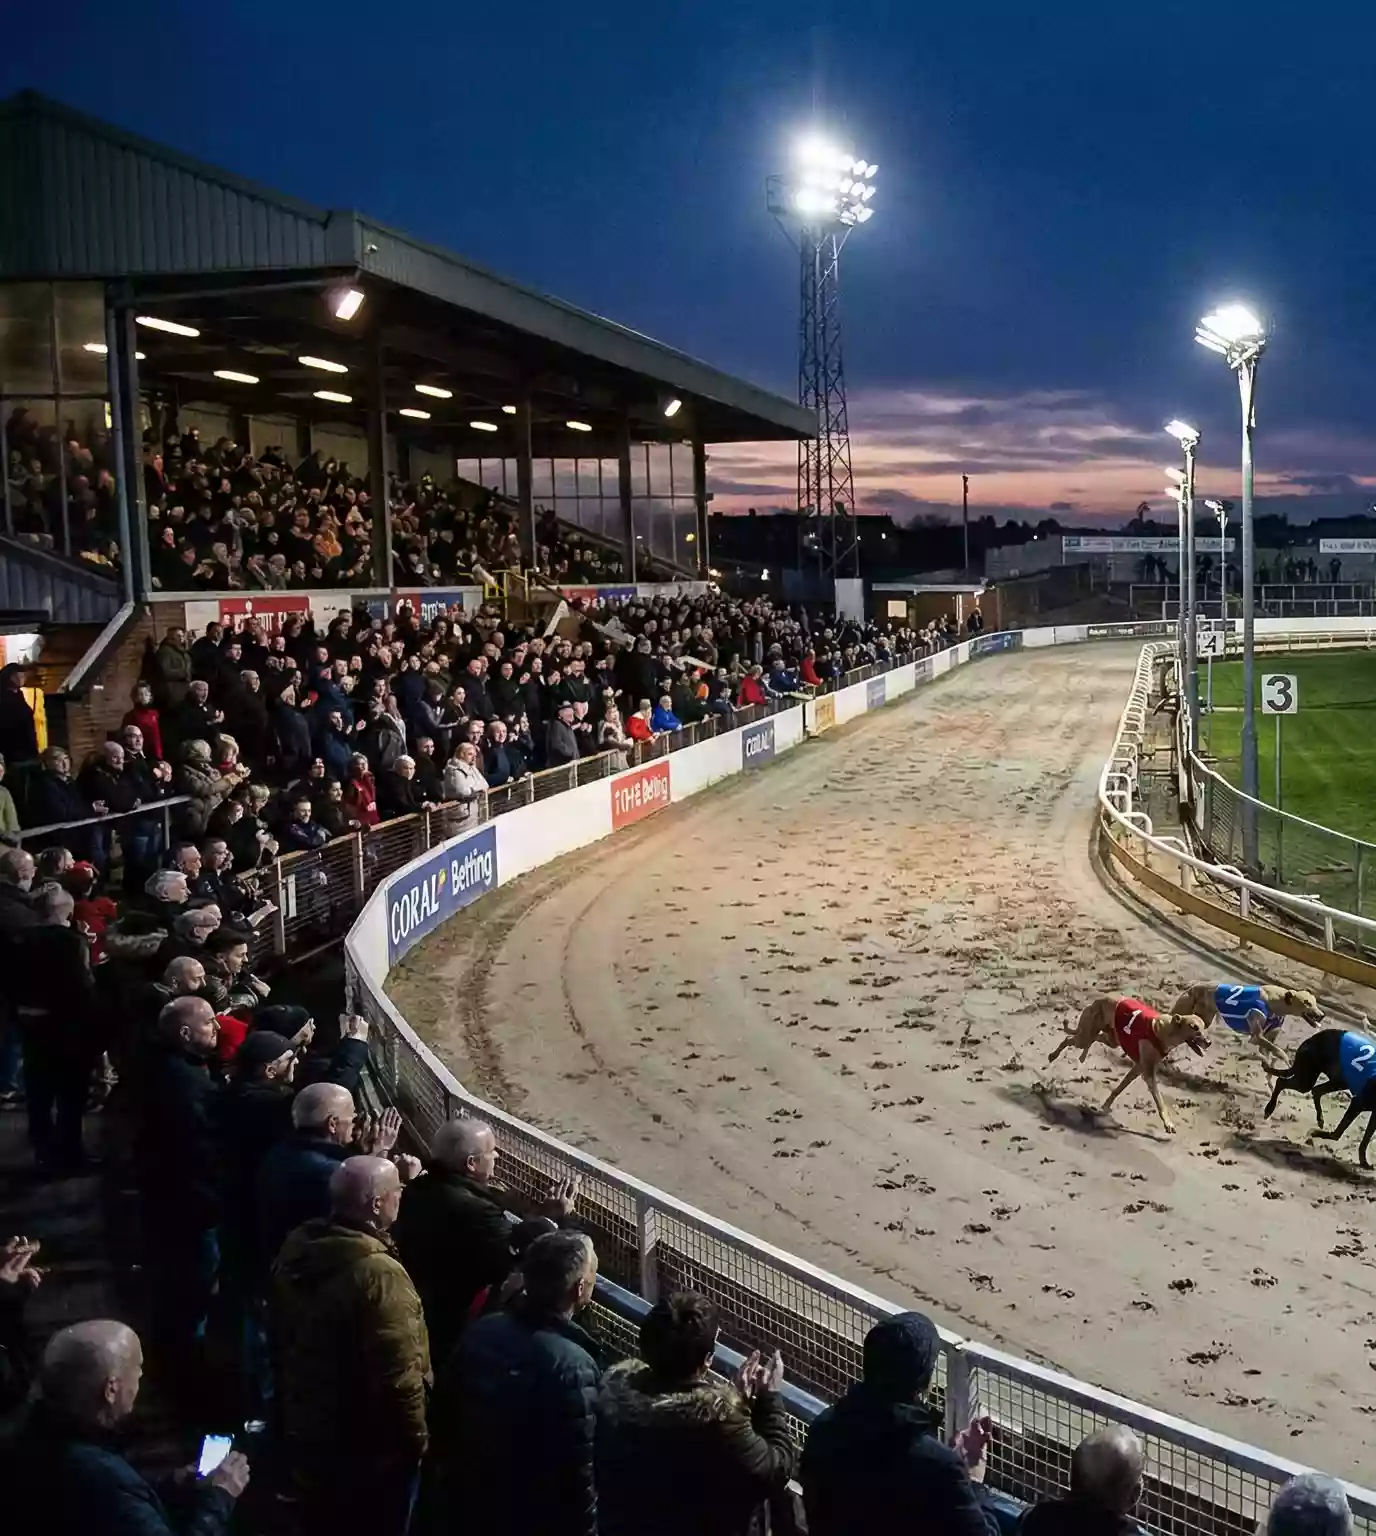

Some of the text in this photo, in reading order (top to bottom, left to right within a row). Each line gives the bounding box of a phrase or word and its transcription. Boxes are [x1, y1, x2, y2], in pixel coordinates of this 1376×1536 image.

[1266, 675, 1293, 712] 3
[391, 848, 493, 945] CORAL Betting
[1224, 985, 1244, 1006] 2
[1123, 1009, 1142, 1035] 1
[1350, 1044, 1376, 1072] 2
